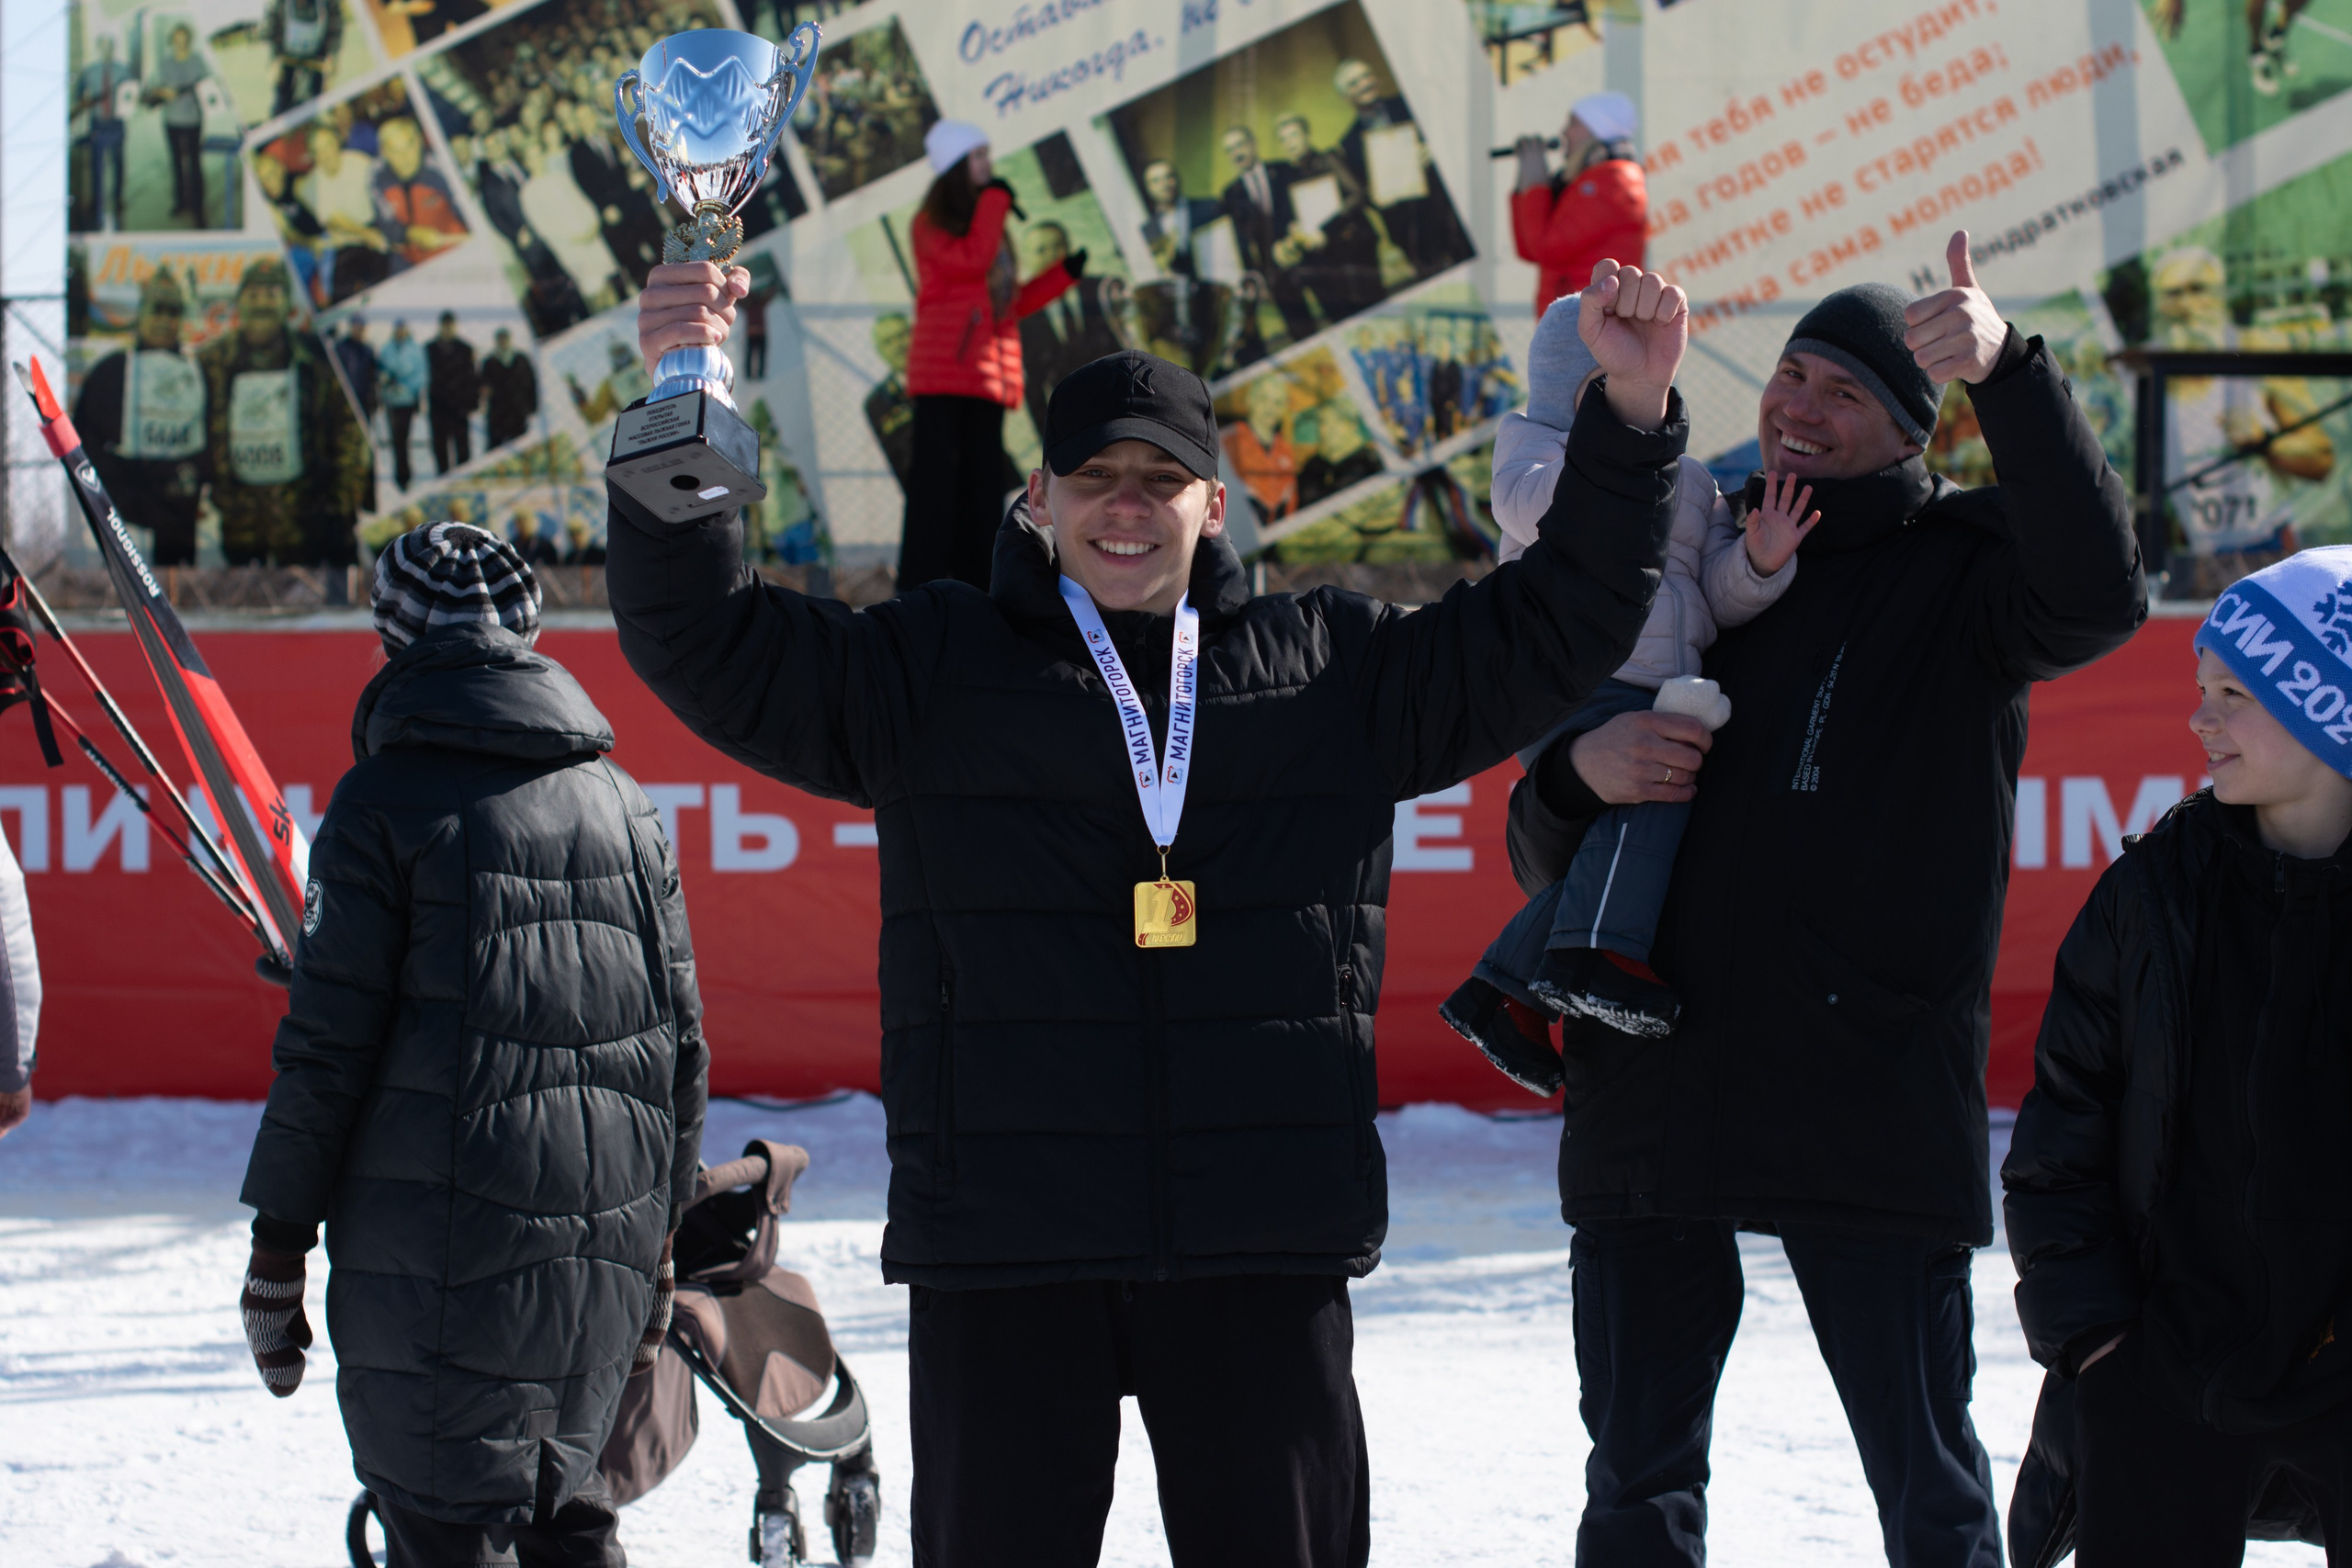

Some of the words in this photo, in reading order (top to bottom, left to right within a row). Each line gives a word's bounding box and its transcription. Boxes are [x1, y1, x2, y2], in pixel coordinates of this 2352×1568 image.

[1687, 96, 1775, 152] тебя
[1778, 68, 1827, 107] не
[1696, 140, 1808, 212] годов
[1844, 97, 1893, 137] не
[1799, 181, 1846, 221] не
[1854, 95, 2019, 193] старятся
[1789, 225, 1882, 286] сама
[1888, 136, 2044, 239] молода!
[1972, 146, 2186, 265] ондратковская
[107, 505, 161, 598] ROSSIGNOL
[2208, 592, 2295, 677] СИИ
[1094, 646, 1151, 765] МАГНИТОГОРСК
[1170, 648, 1193, 761] МАГНИТОГОРСК
[1806, 699, 1821, 736] GARMENT
[1801, 763, 1812, 791] BASED
[1811, 765, 1820, 784] 2004
